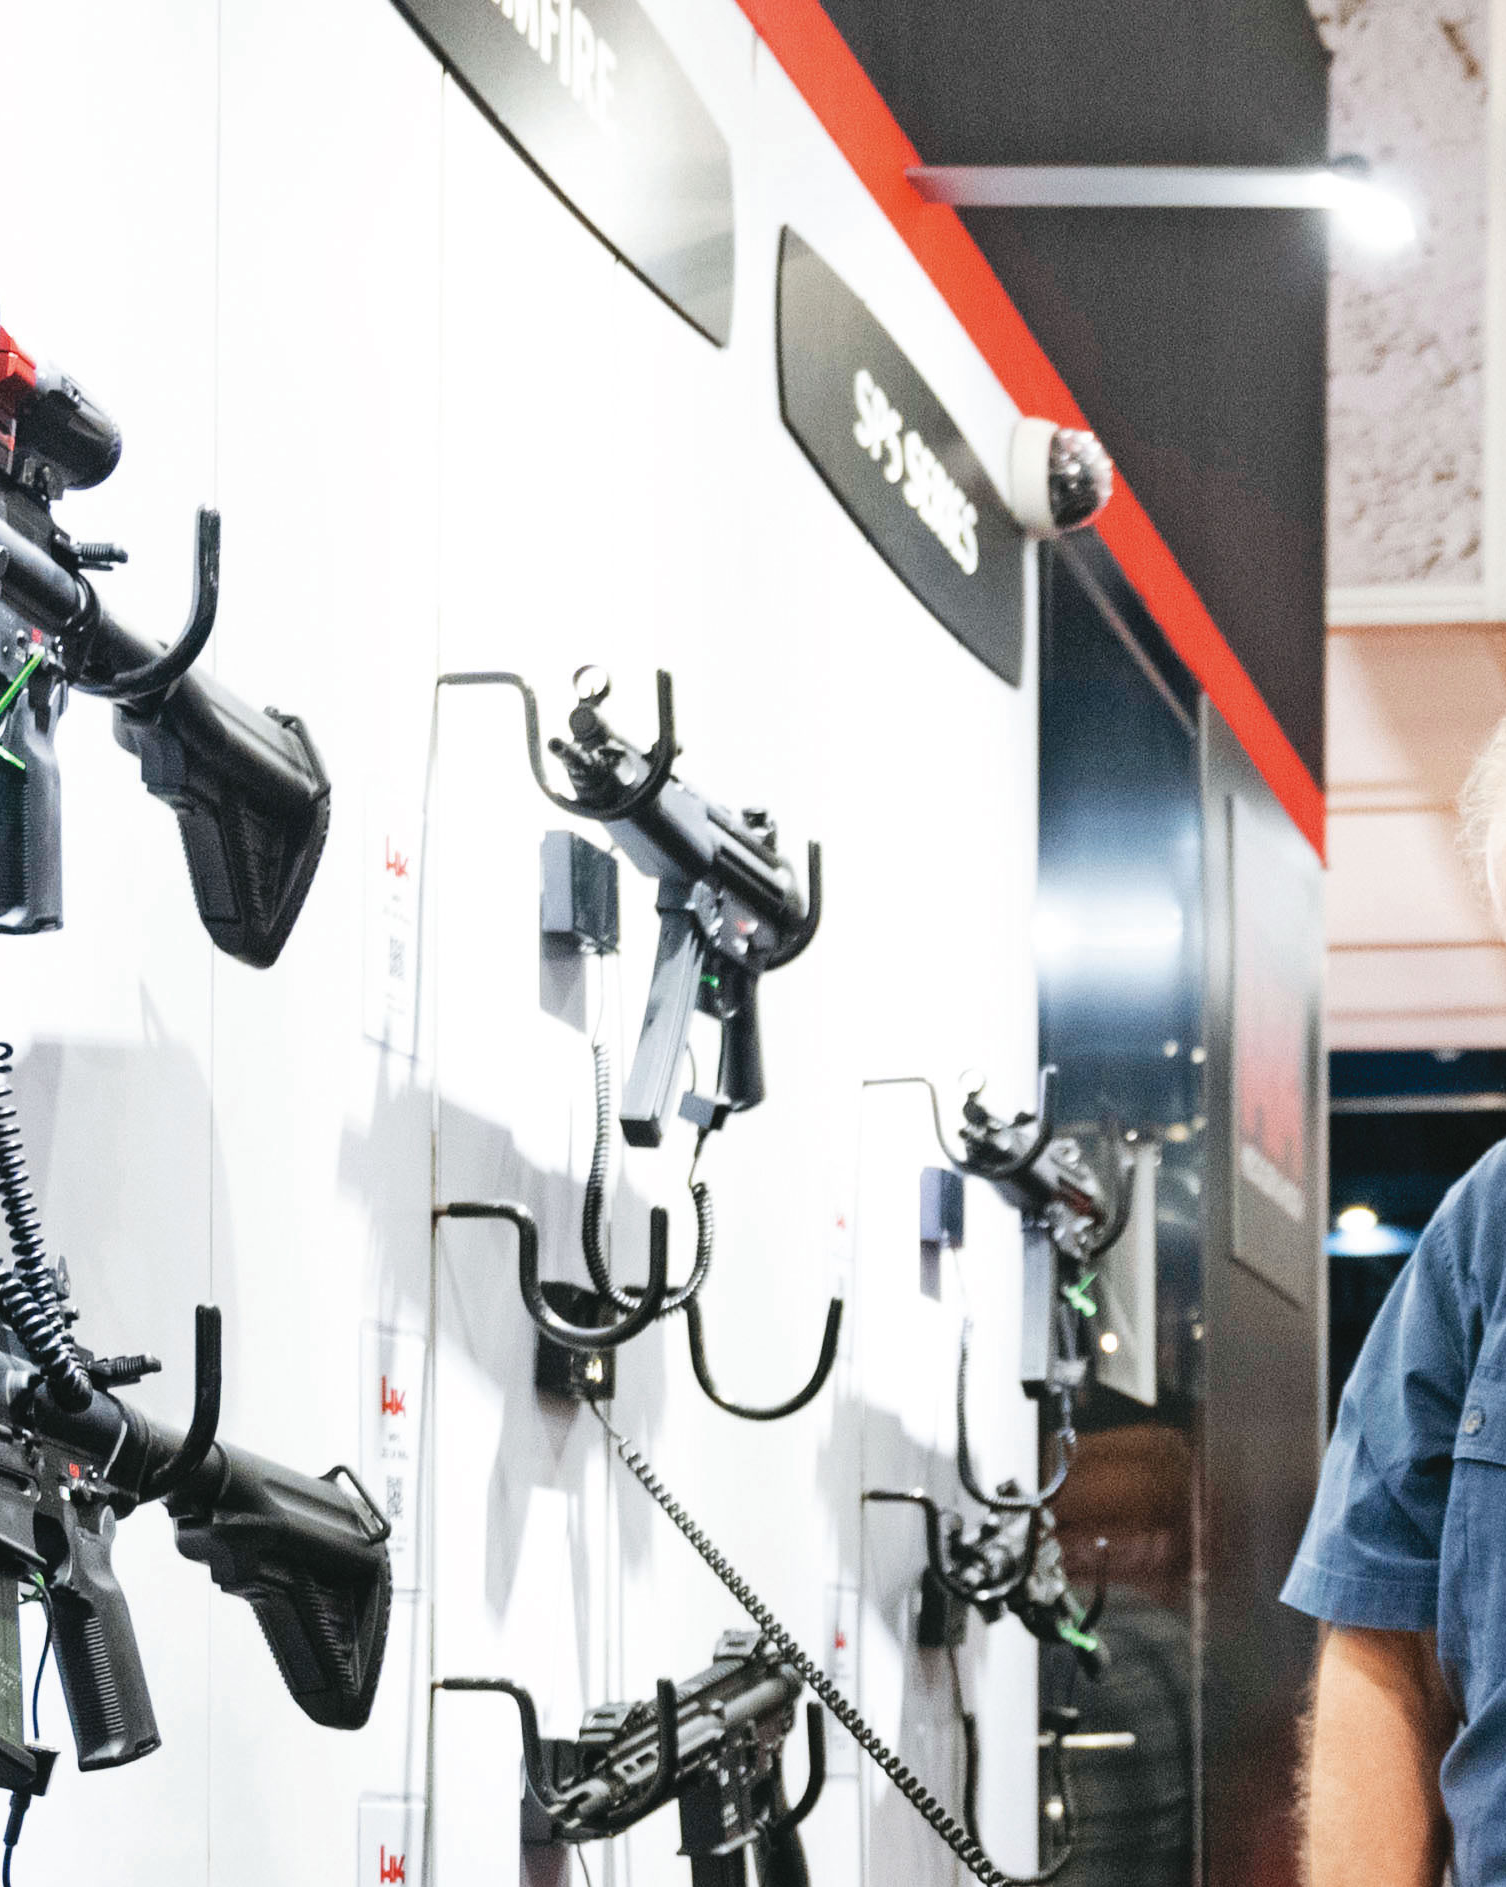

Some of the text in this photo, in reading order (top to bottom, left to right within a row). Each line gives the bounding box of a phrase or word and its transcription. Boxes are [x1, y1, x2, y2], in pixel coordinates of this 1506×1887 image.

[492, 0, 617, 122] FIRE
[903, 430, 979, 576] SERIES
[380, 1844, 406, 1884] HK
